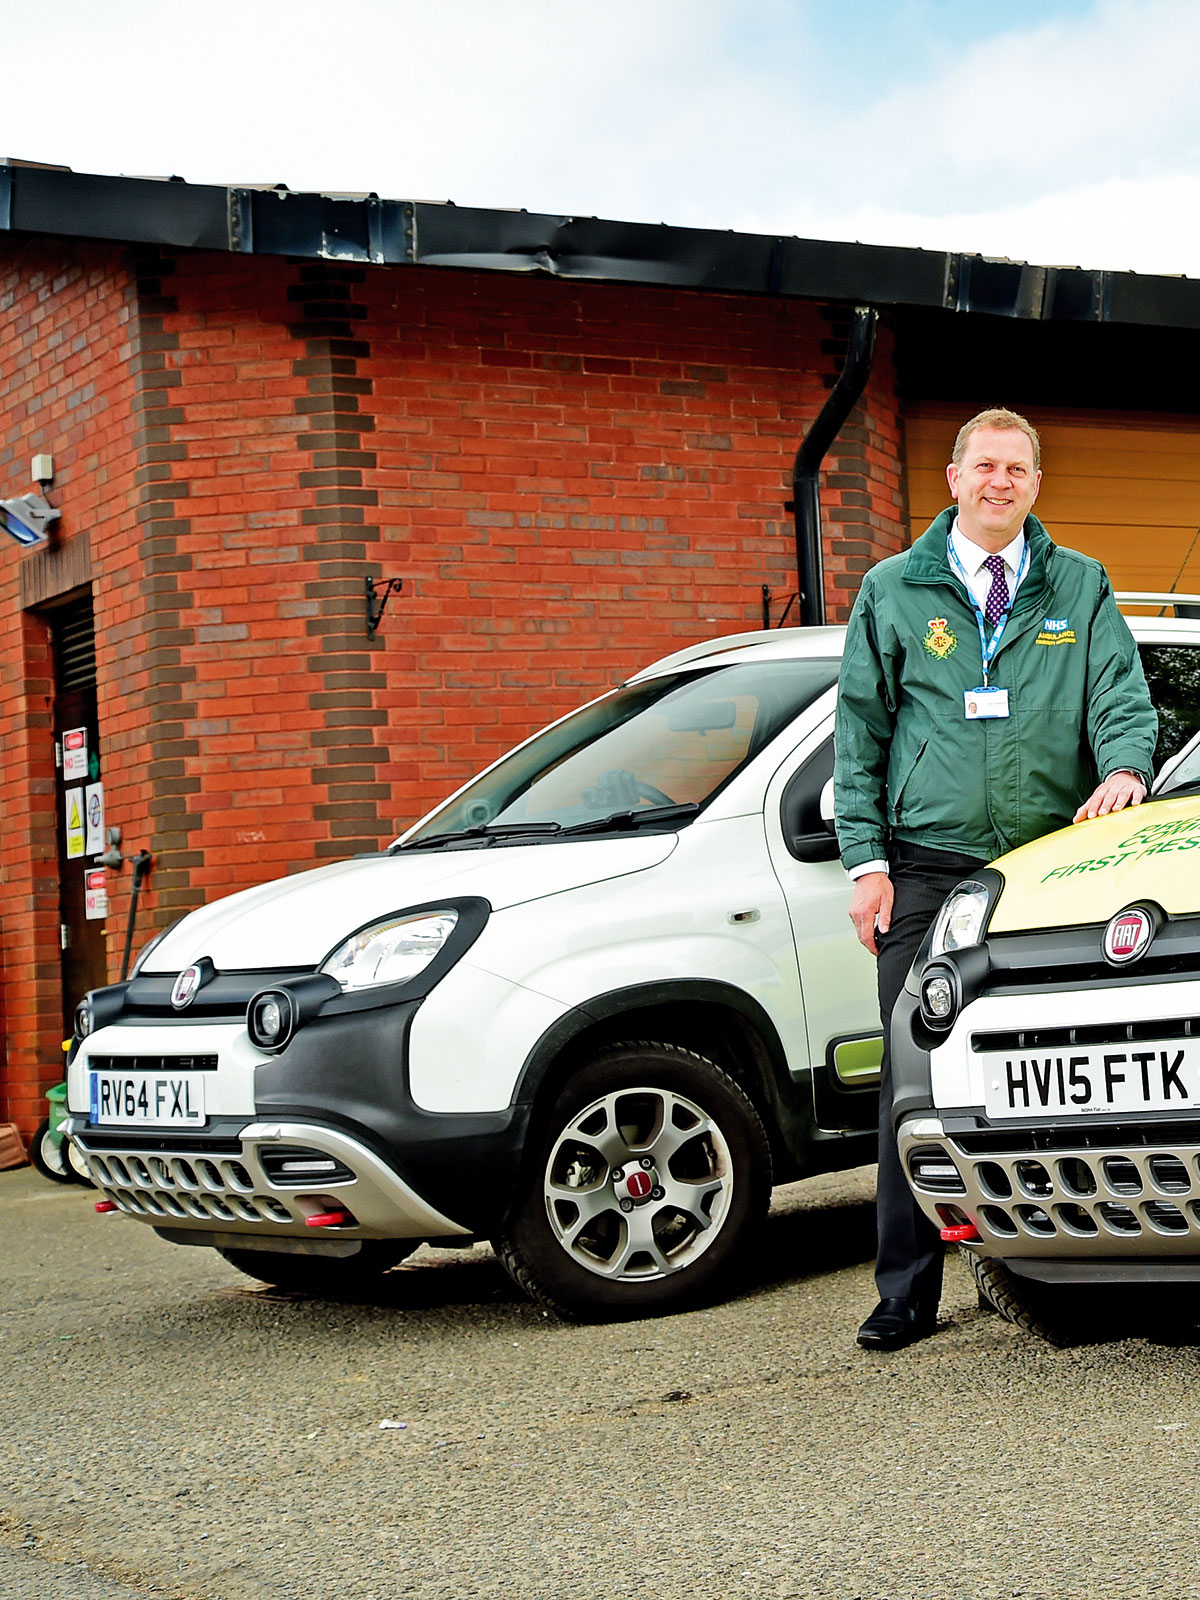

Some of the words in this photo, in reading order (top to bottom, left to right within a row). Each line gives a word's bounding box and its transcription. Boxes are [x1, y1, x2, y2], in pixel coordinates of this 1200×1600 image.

[1044, 619, 1068, 630] NHS
[1040, 851, 1138, 884] FIRST
[1113, 924, 1142, 948] FIAT
[1006, 1056, 1092, 1108] HV15
[1103, 1050, 1189, 1104] FTK
[101, 1079, 149, 1117] RV64
[155, 1080, 199, 1118] FXL
